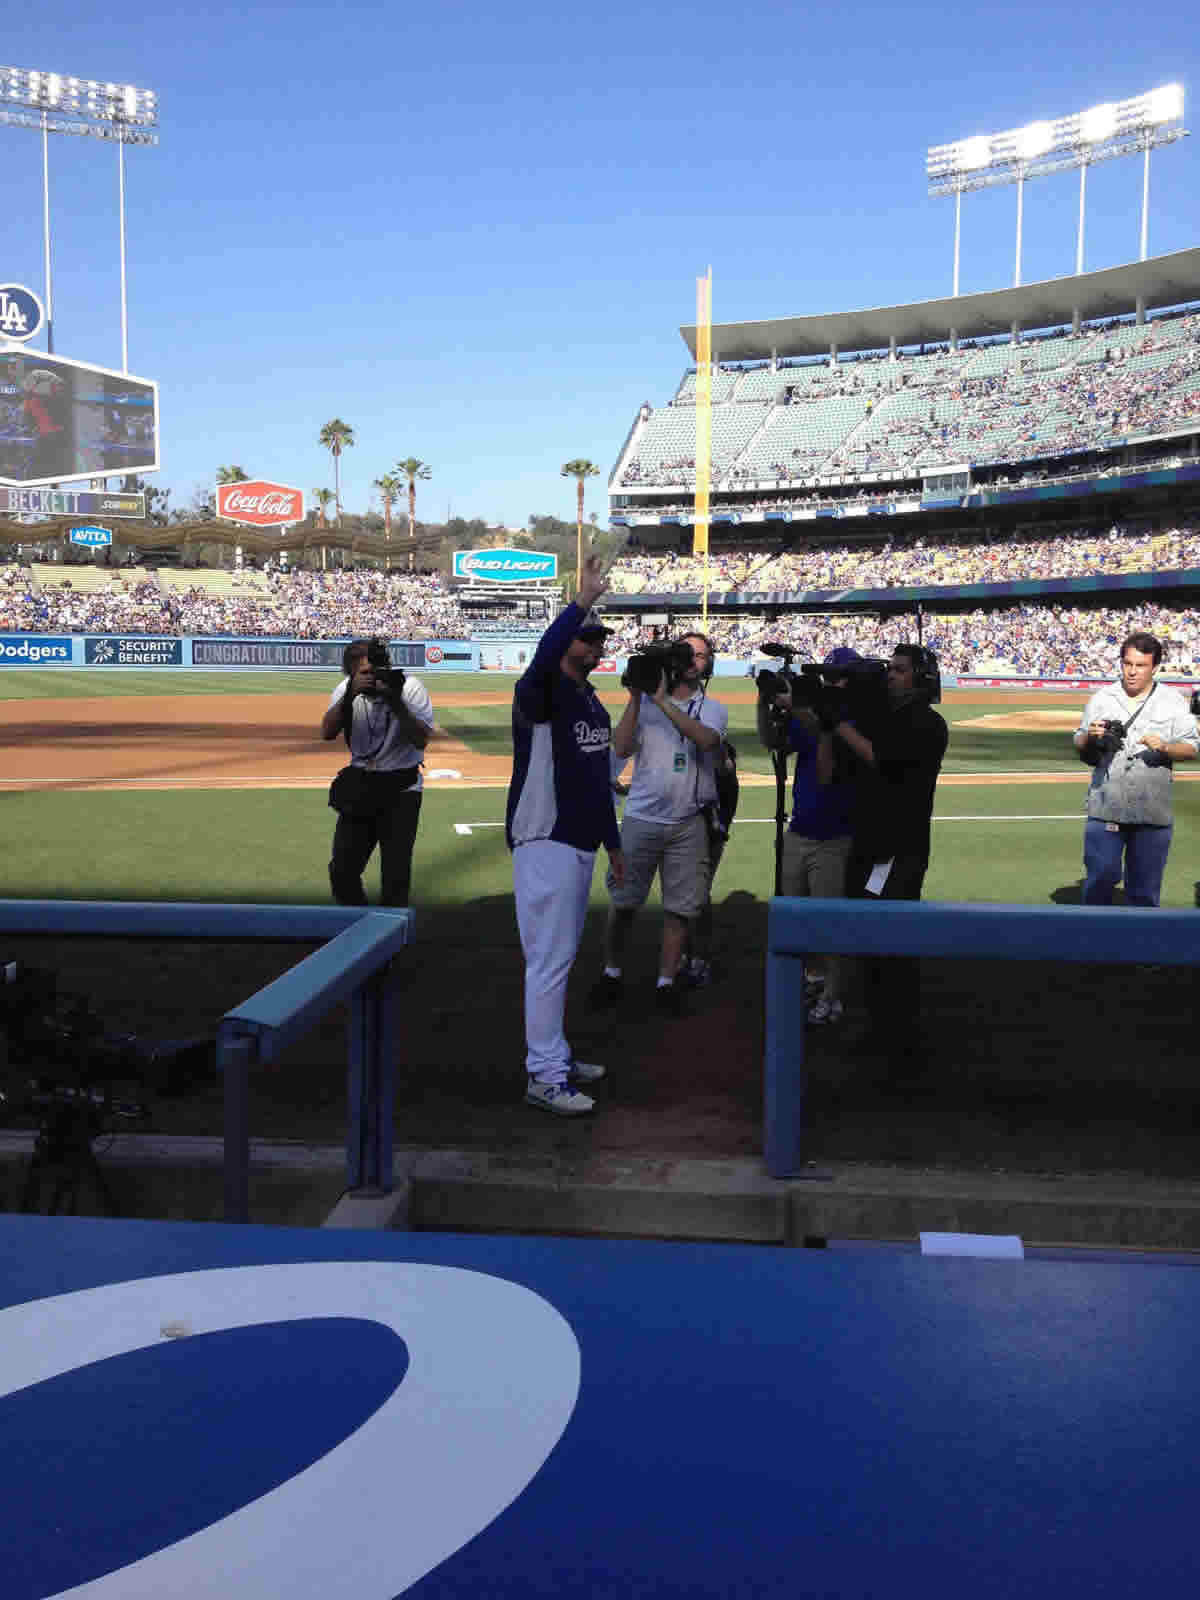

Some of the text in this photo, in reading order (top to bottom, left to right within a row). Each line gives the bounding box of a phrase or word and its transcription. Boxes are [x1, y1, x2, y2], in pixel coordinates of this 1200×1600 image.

[8, 490, 80, 512] BECKETT
[224, 490, 297, 514] Coca-Cola
[119, 640, 175, 650] SECURITY
